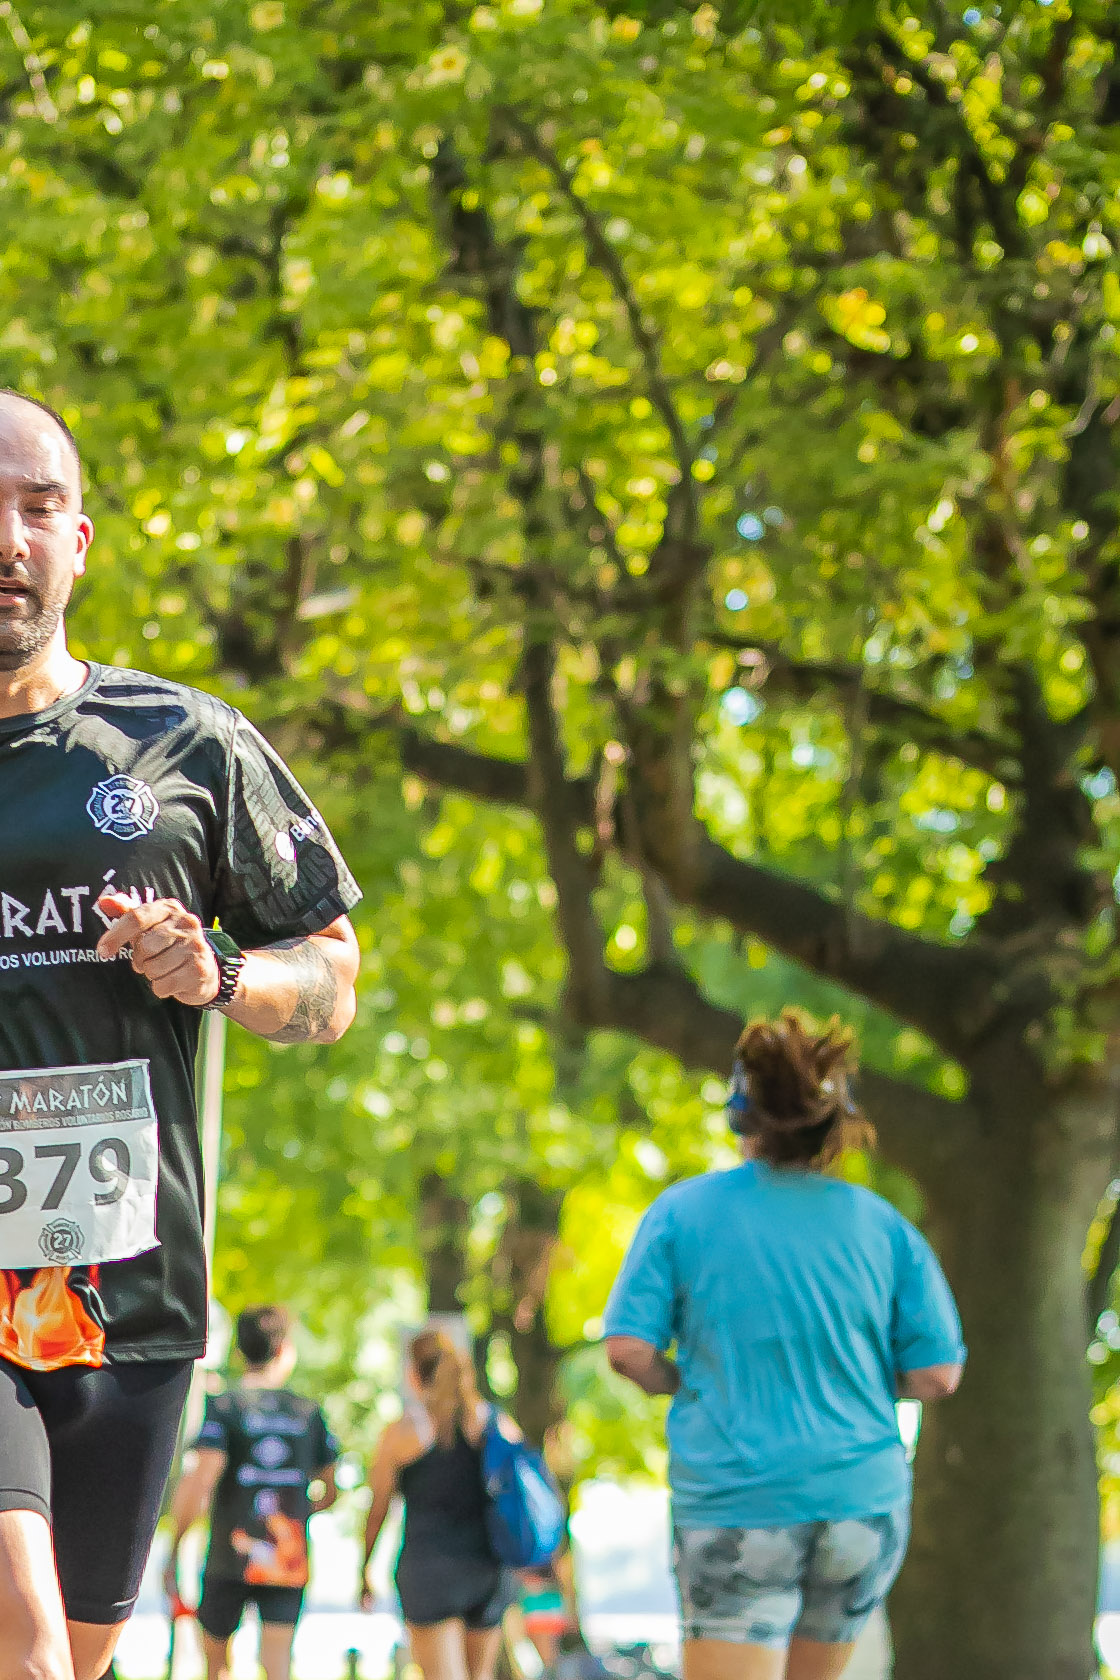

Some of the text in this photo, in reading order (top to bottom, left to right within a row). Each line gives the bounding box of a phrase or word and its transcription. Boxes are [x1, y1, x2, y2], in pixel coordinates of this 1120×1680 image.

[111, 793, 135, 815] 27
[9, 1075, 128, 1115] MARATÓN
[53, 1232, 72, 1249] 27
